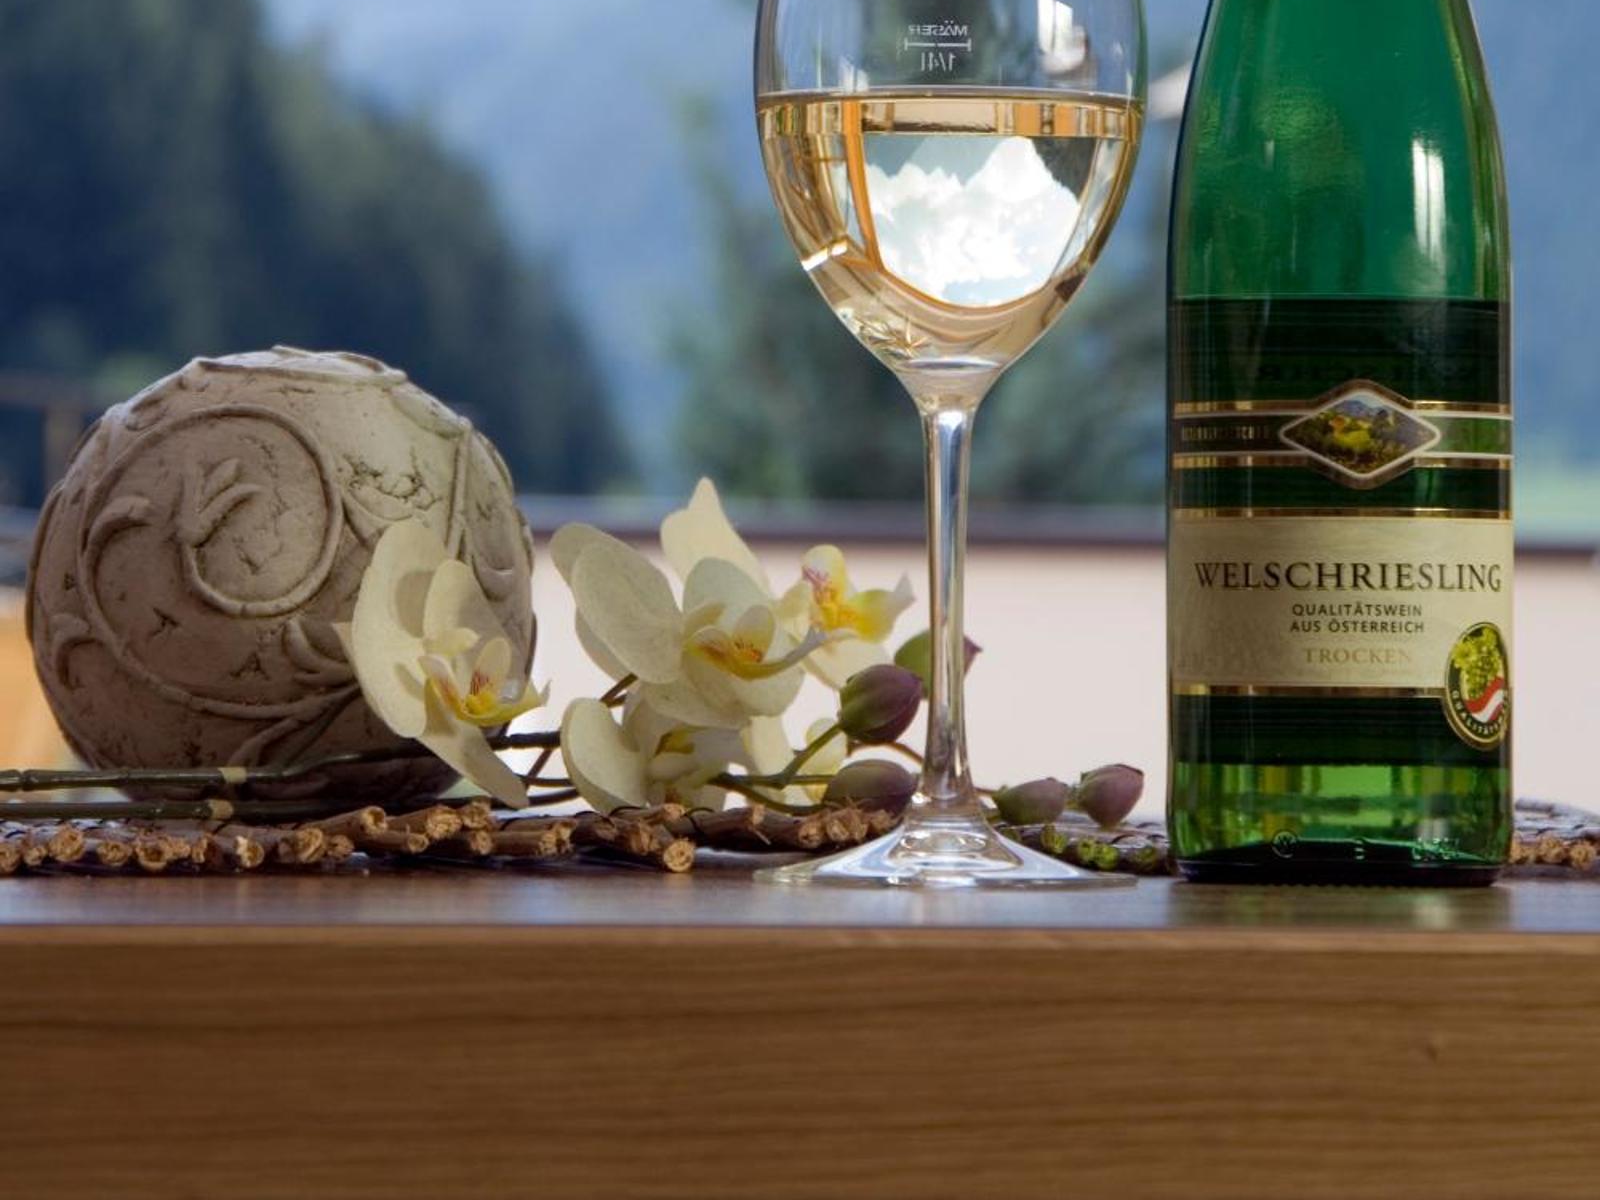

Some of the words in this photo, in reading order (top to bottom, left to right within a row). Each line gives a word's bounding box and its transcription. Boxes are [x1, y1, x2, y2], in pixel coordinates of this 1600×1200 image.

[1194, 562, 1501, 593] WELSCHRIESLING
[1292, 603, 1423, 618] QUALITÄTSWEIN
[1290, 621, 1321, 633] AUS
[1328, 618, 1425, 633] ÖSTERREICH
[1304, 648, 1412, 665] TROCKEN
